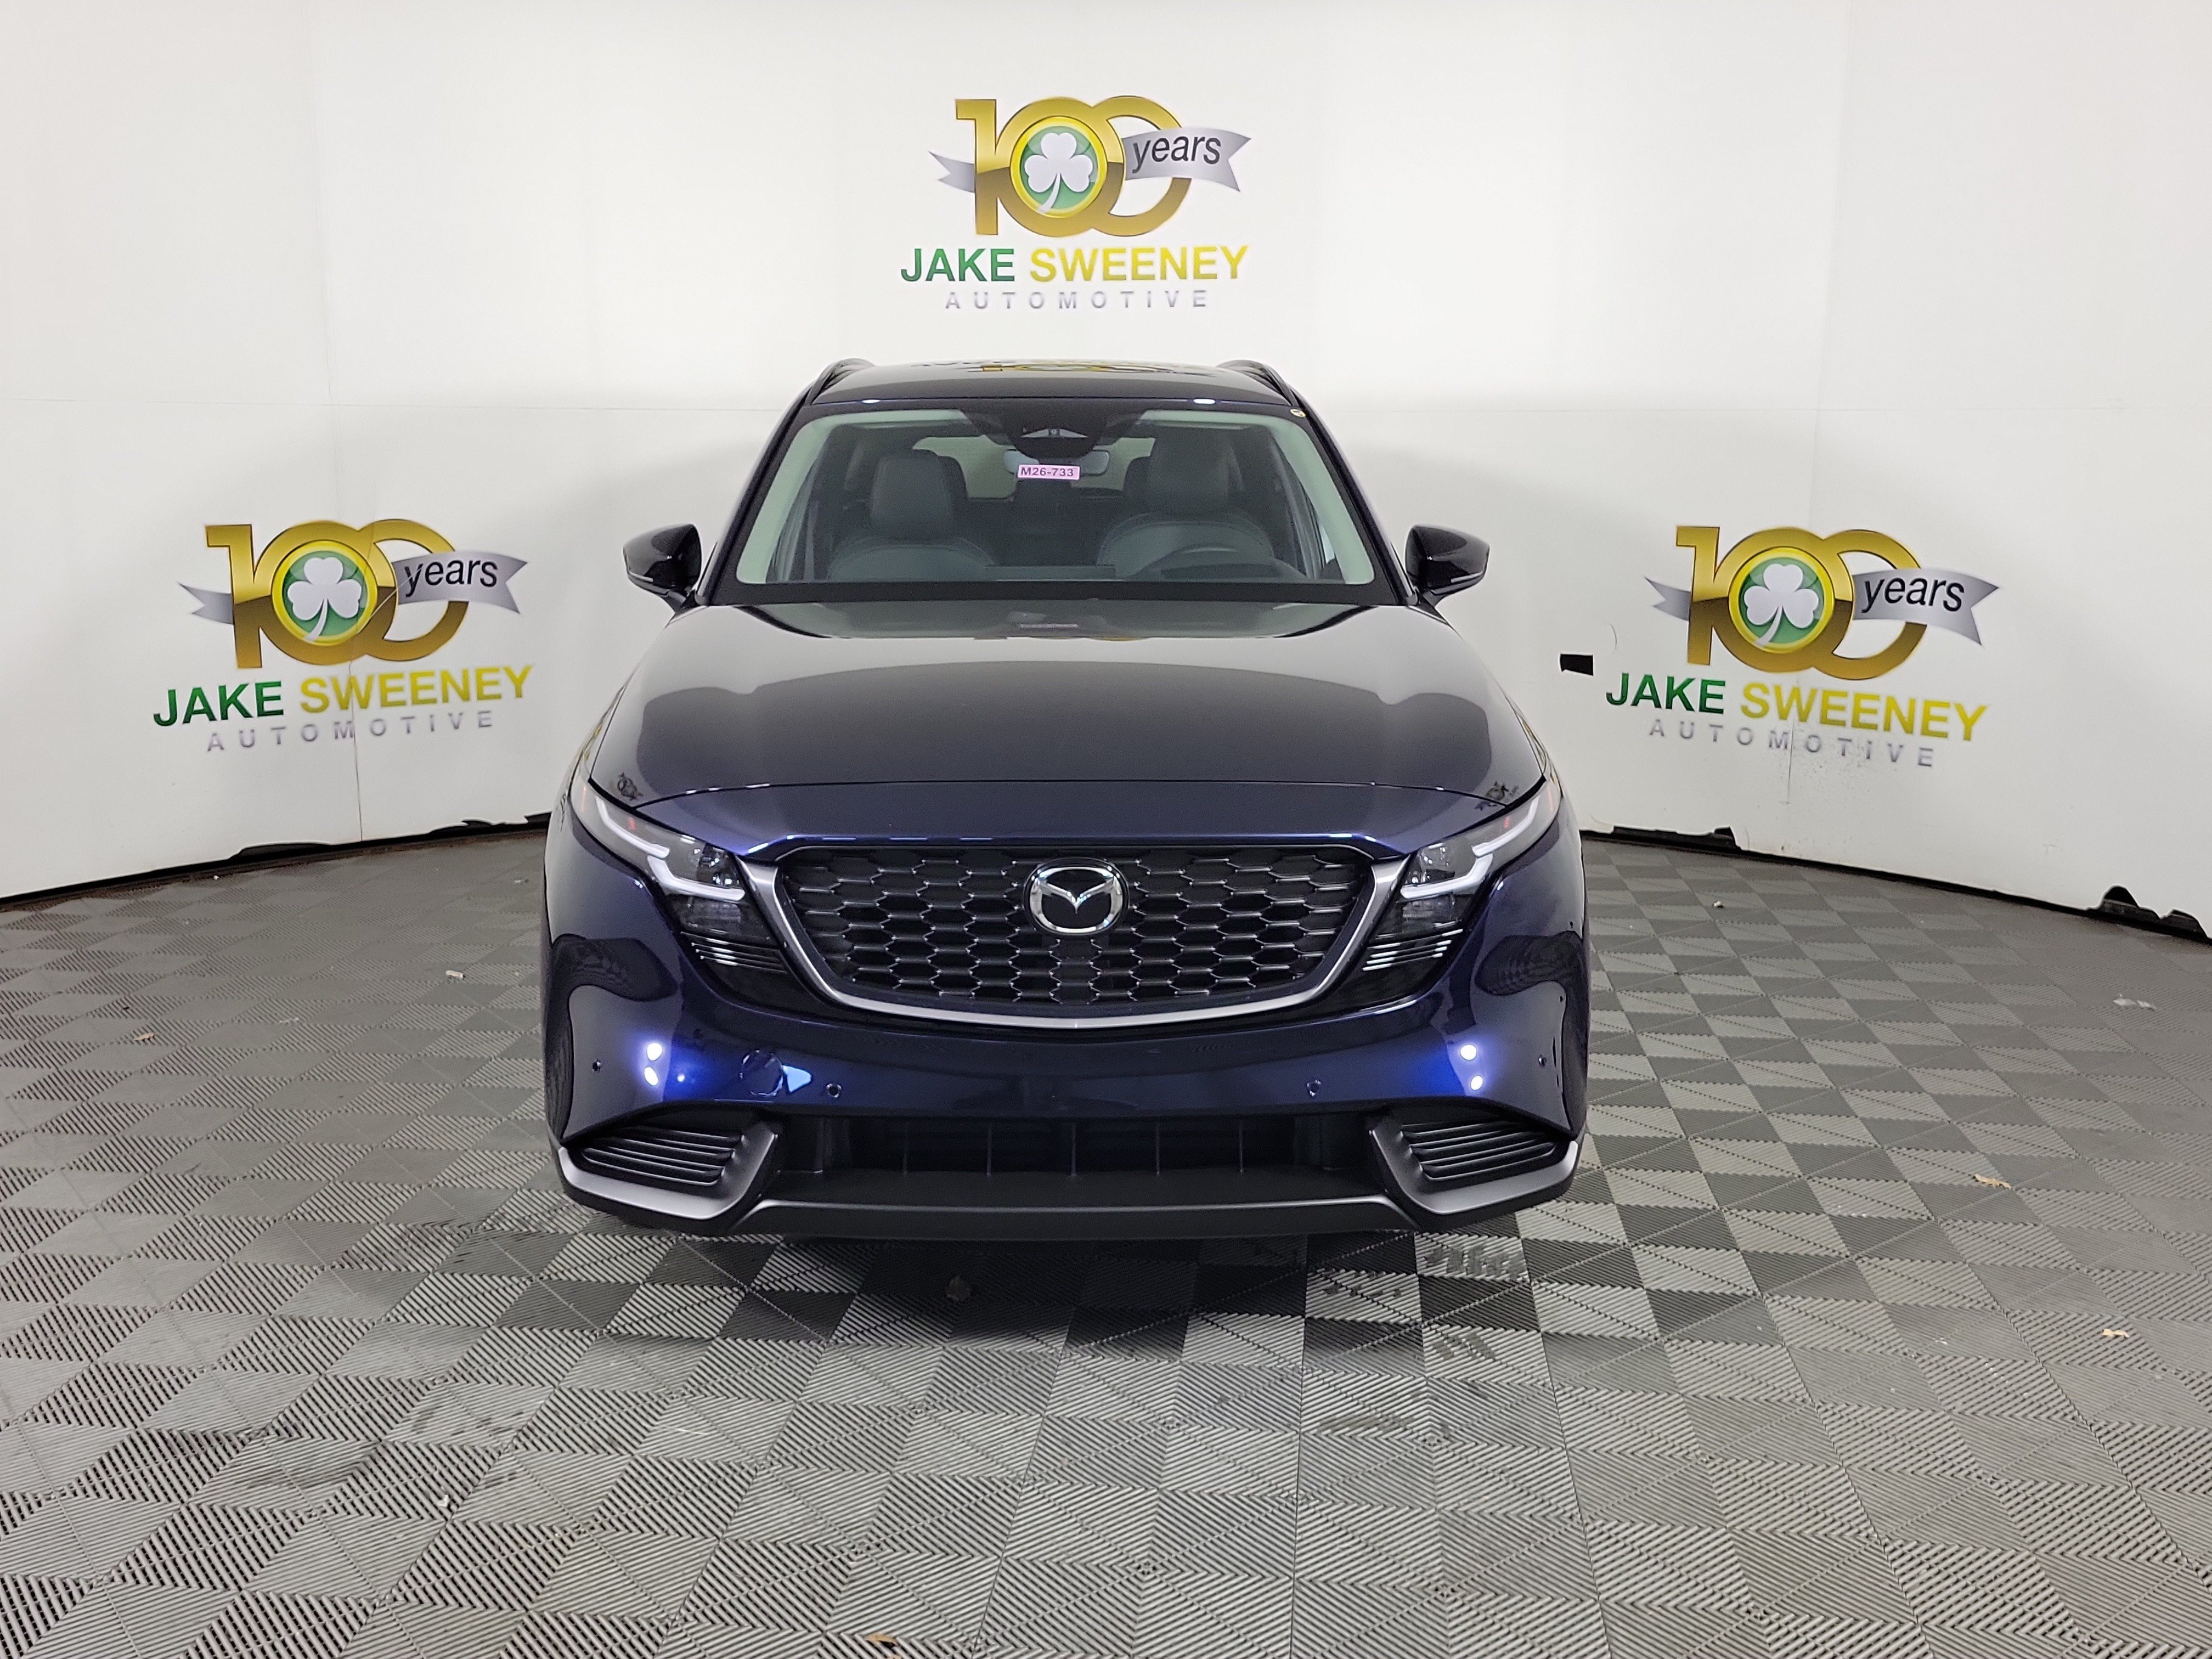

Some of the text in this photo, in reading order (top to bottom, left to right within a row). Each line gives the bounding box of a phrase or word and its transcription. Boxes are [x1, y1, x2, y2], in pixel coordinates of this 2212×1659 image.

[1131, 135, 1222, 174] years
[901, 245, 1248, 283] JAKE SWEENEY
[945, 290, 1207, 309] AUTOMOTIVE
[1021, 467, 1074, 476] M26-733
[404, 558, 498, 597] years
[1861, 577, 1965, 613] years
[153, 664, 533, 727] JAKE SWEENEY
[1606, 672, 1988, 742] JAKE SWEENEY
[207, 710, 493, 752] AUTOMOTIVE
[1649, 719, 1934, 767] AUTOMOTIVE
